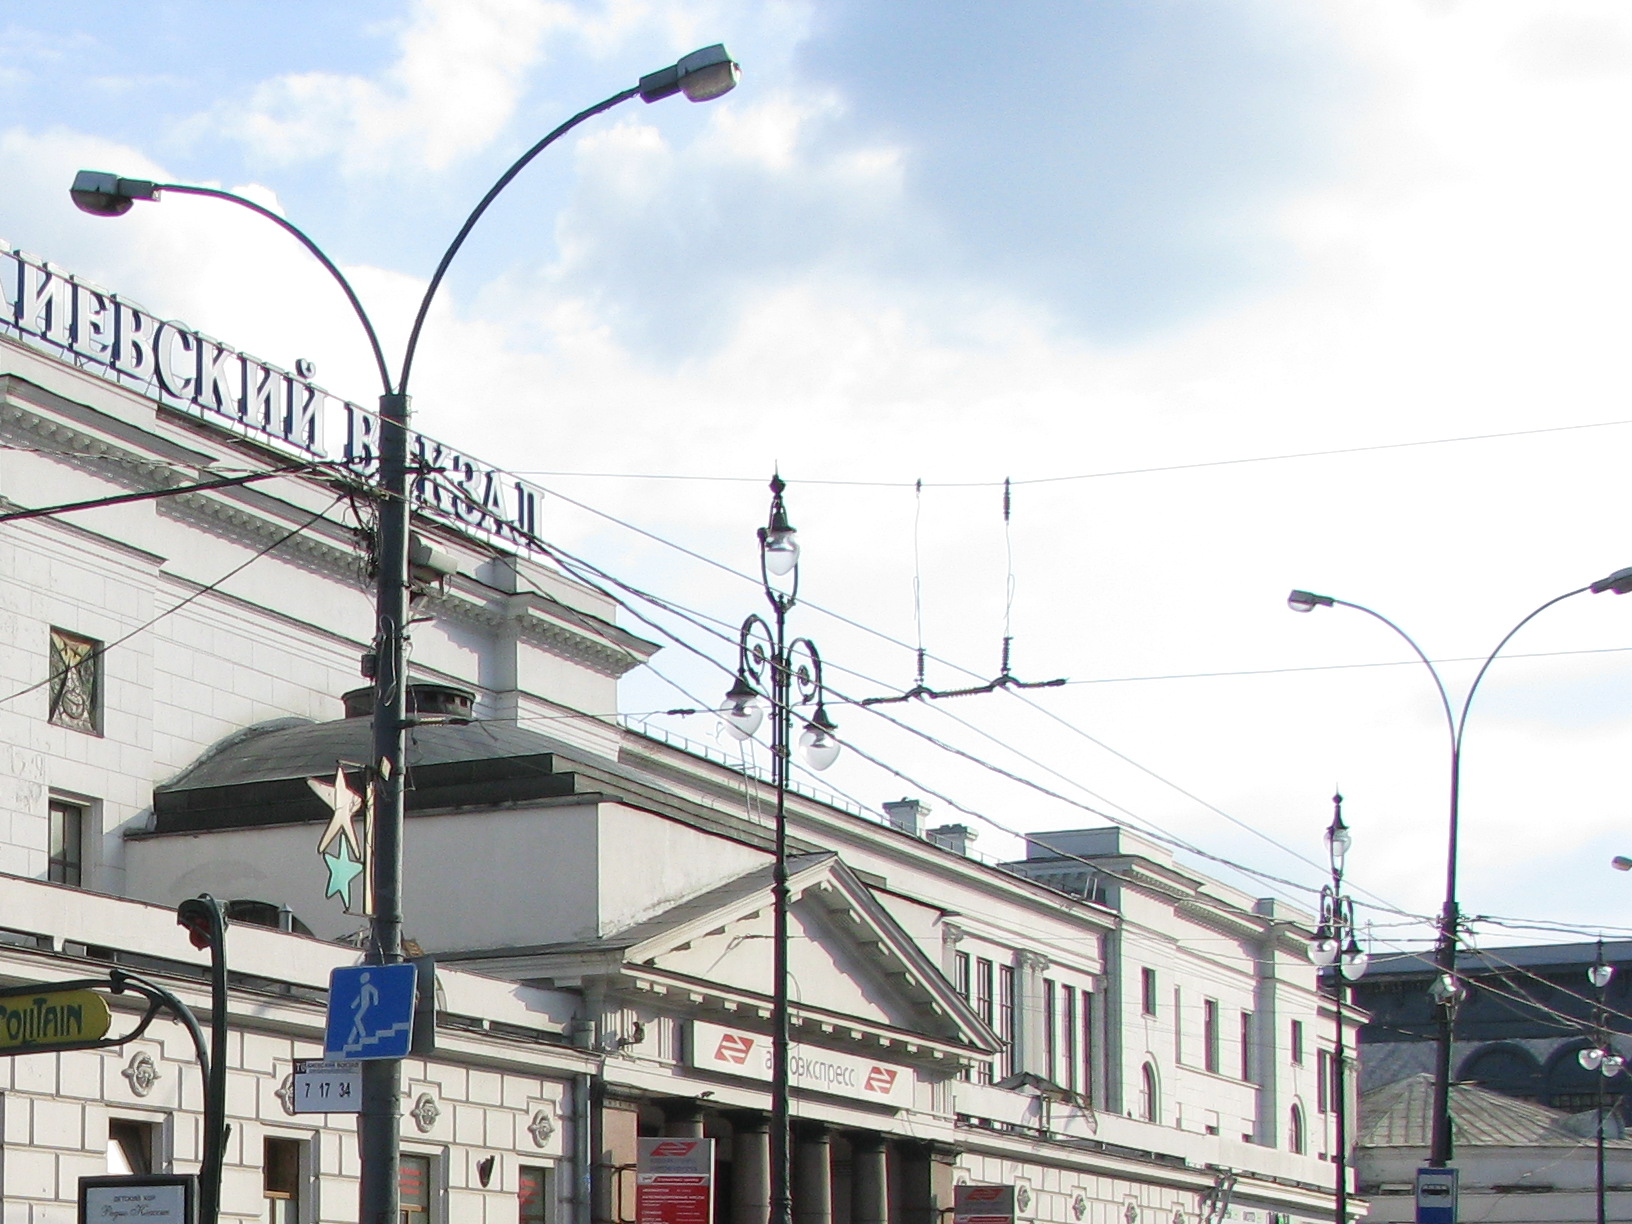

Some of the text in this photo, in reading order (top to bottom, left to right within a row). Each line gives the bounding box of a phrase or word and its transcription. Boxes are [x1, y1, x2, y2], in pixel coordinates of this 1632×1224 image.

[344, 400, 546, 550] ВКЗАЛ
[764, 1048, 856, 1090] аоэкспресс
[305, 1082, 351, 1099] 7 17 34
